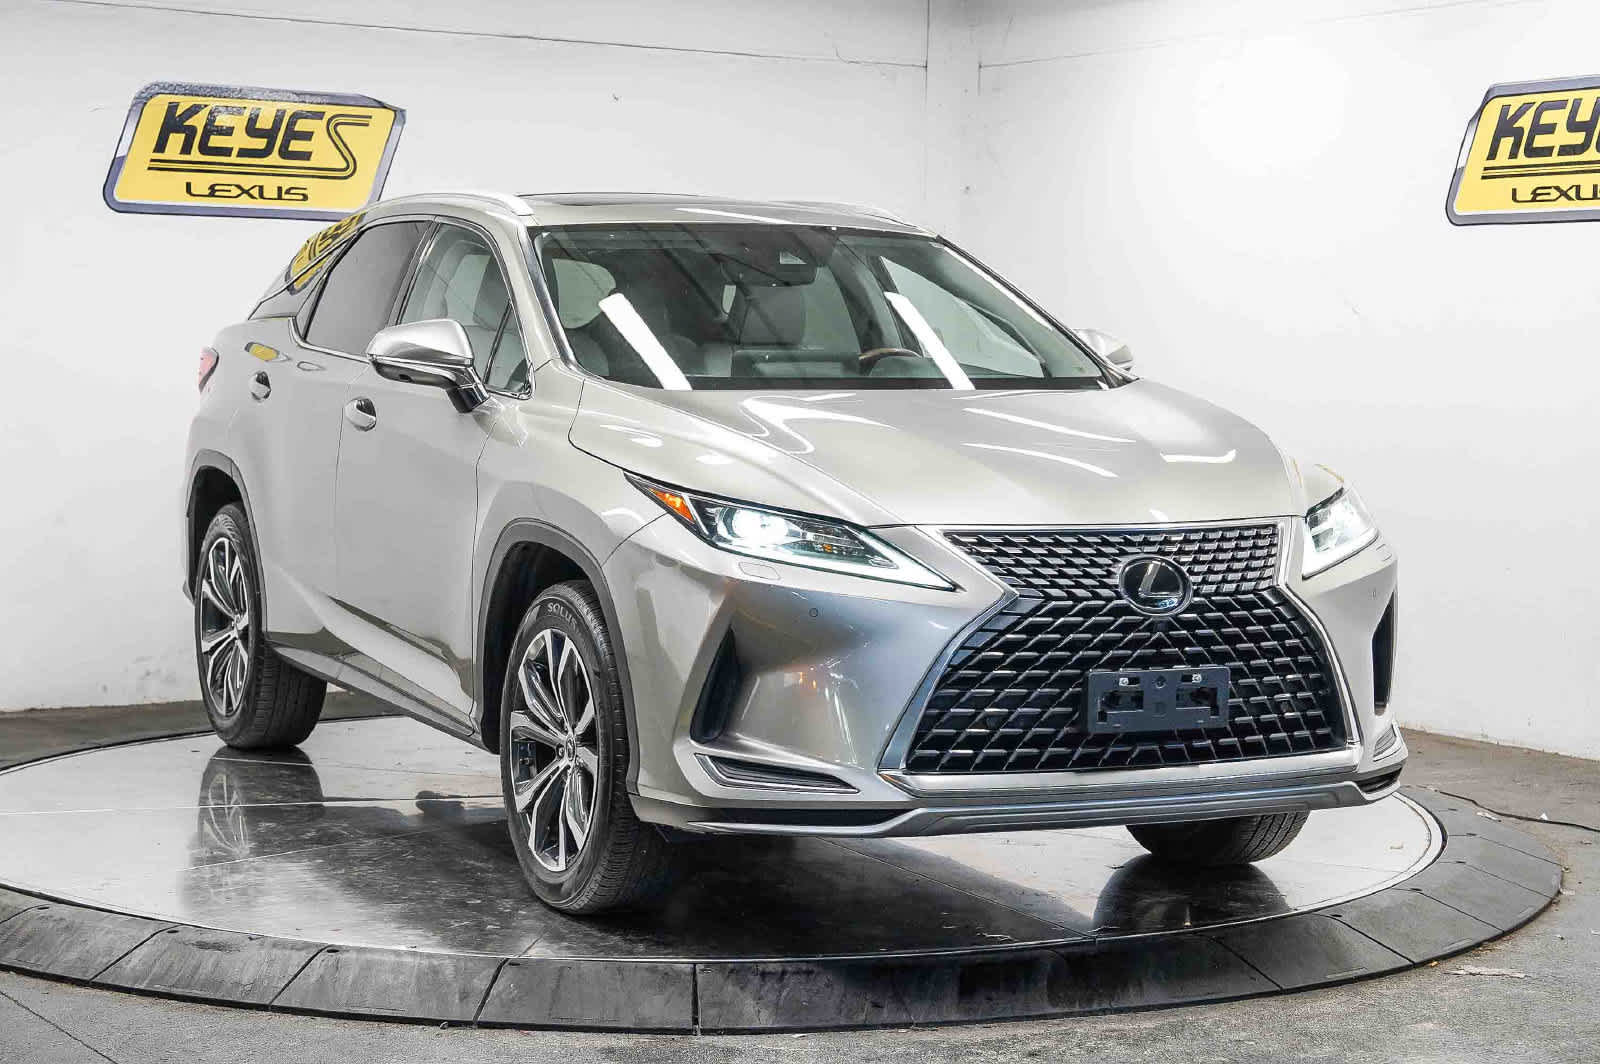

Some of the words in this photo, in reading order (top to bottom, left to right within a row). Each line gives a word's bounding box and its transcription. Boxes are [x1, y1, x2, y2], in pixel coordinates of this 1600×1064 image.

[152, 101, 373, 178] KEYES
[1486, 95, 1600, 161] KEY
[185, 181, 308, 201] LEXUS
[1511, 183, 1600, 204] LEXU
